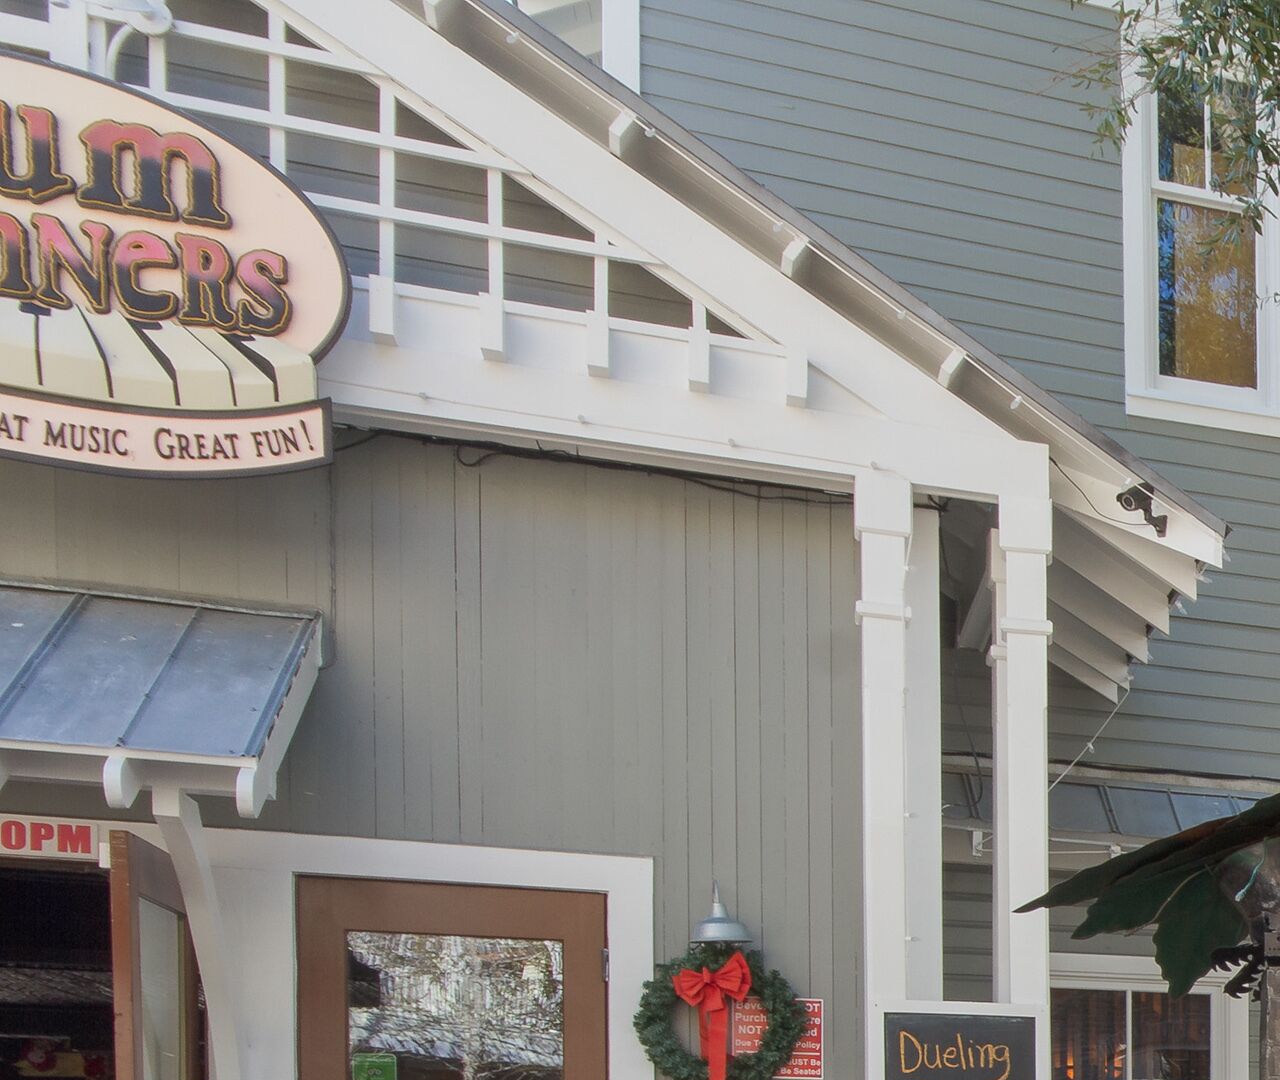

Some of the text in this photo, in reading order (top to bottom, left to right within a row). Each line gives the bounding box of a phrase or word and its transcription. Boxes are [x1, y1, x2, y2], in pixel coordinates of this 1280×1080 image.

[43, 420, 129, 457] MUSIC
[153, 428, 238, 460] GREAT
[251, 419, 314, 457] FUN!
[805, 1003, 820, 1012] OT
[735, 1013, 767, 1022] Purch
[738, 1025, 762, 1034] NOT
[793, 1067, 821, 1076] Seated
